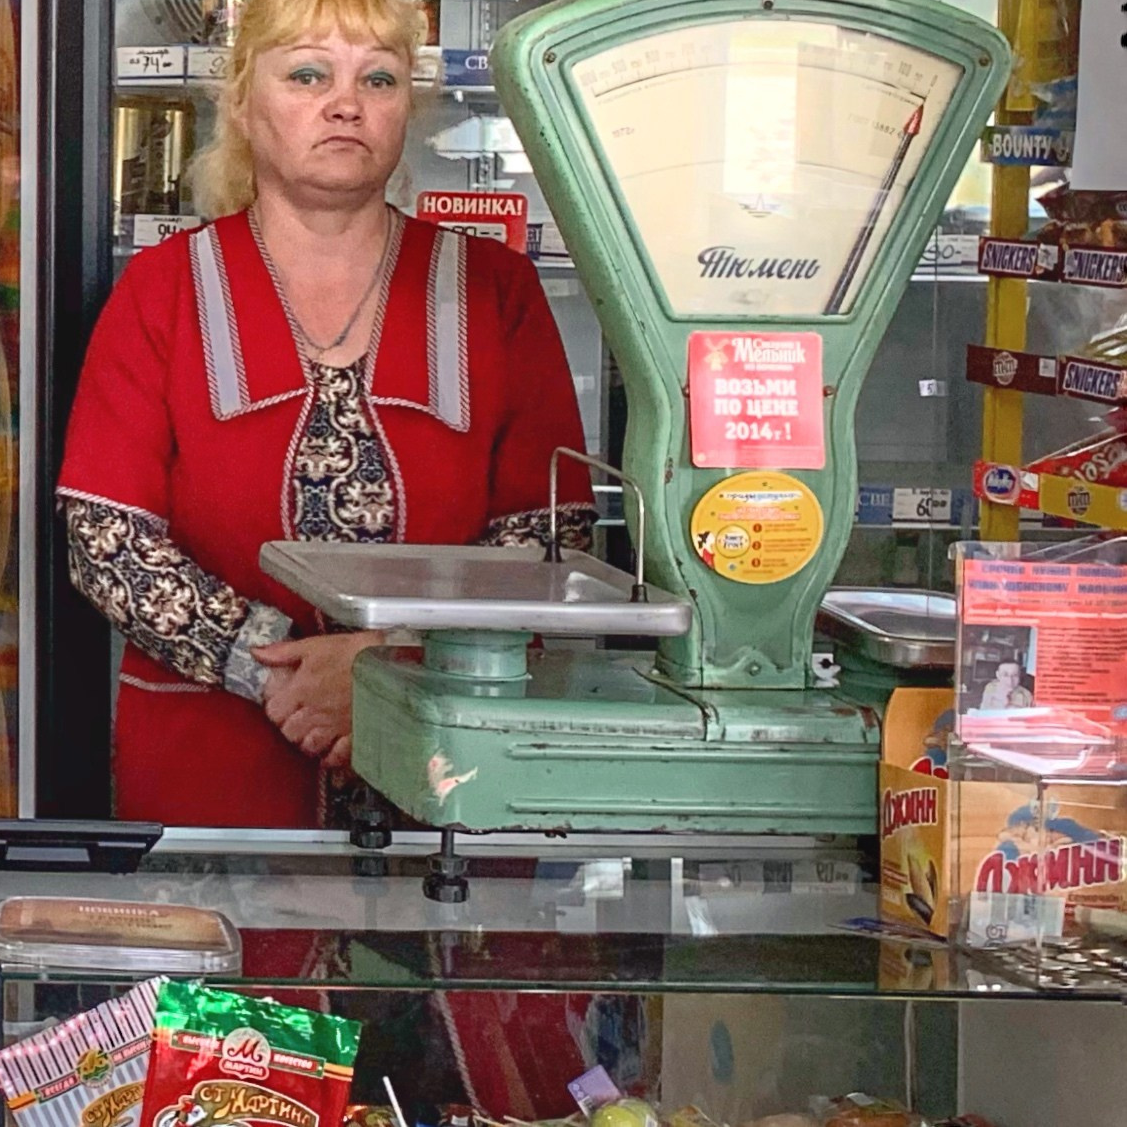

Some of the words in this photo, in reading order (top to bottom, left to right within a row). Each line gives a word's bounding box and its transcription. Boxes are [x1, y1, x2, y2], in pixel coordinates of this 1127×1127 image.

[993, 132, 1052, 160] BOUNTY
[423, 196, 524, 217] НОВИНКА!
[697, 246, 822, 280] Тюмень
[983, 243, 1037, 273] SNICKERS
[732, 337, 806, 365] Мельник
[715, 378, 796, 396] ВОЗЬМИ
[1065, 362, 1120, 397] SNICKERS
[715, 398, 741, 416] ПО
[747, 399, 799, 418] ЦЕНЕ
[883, 788, 938, 840] ДЖИНН
[976, 838, 1123, 894] ДЖИНН
